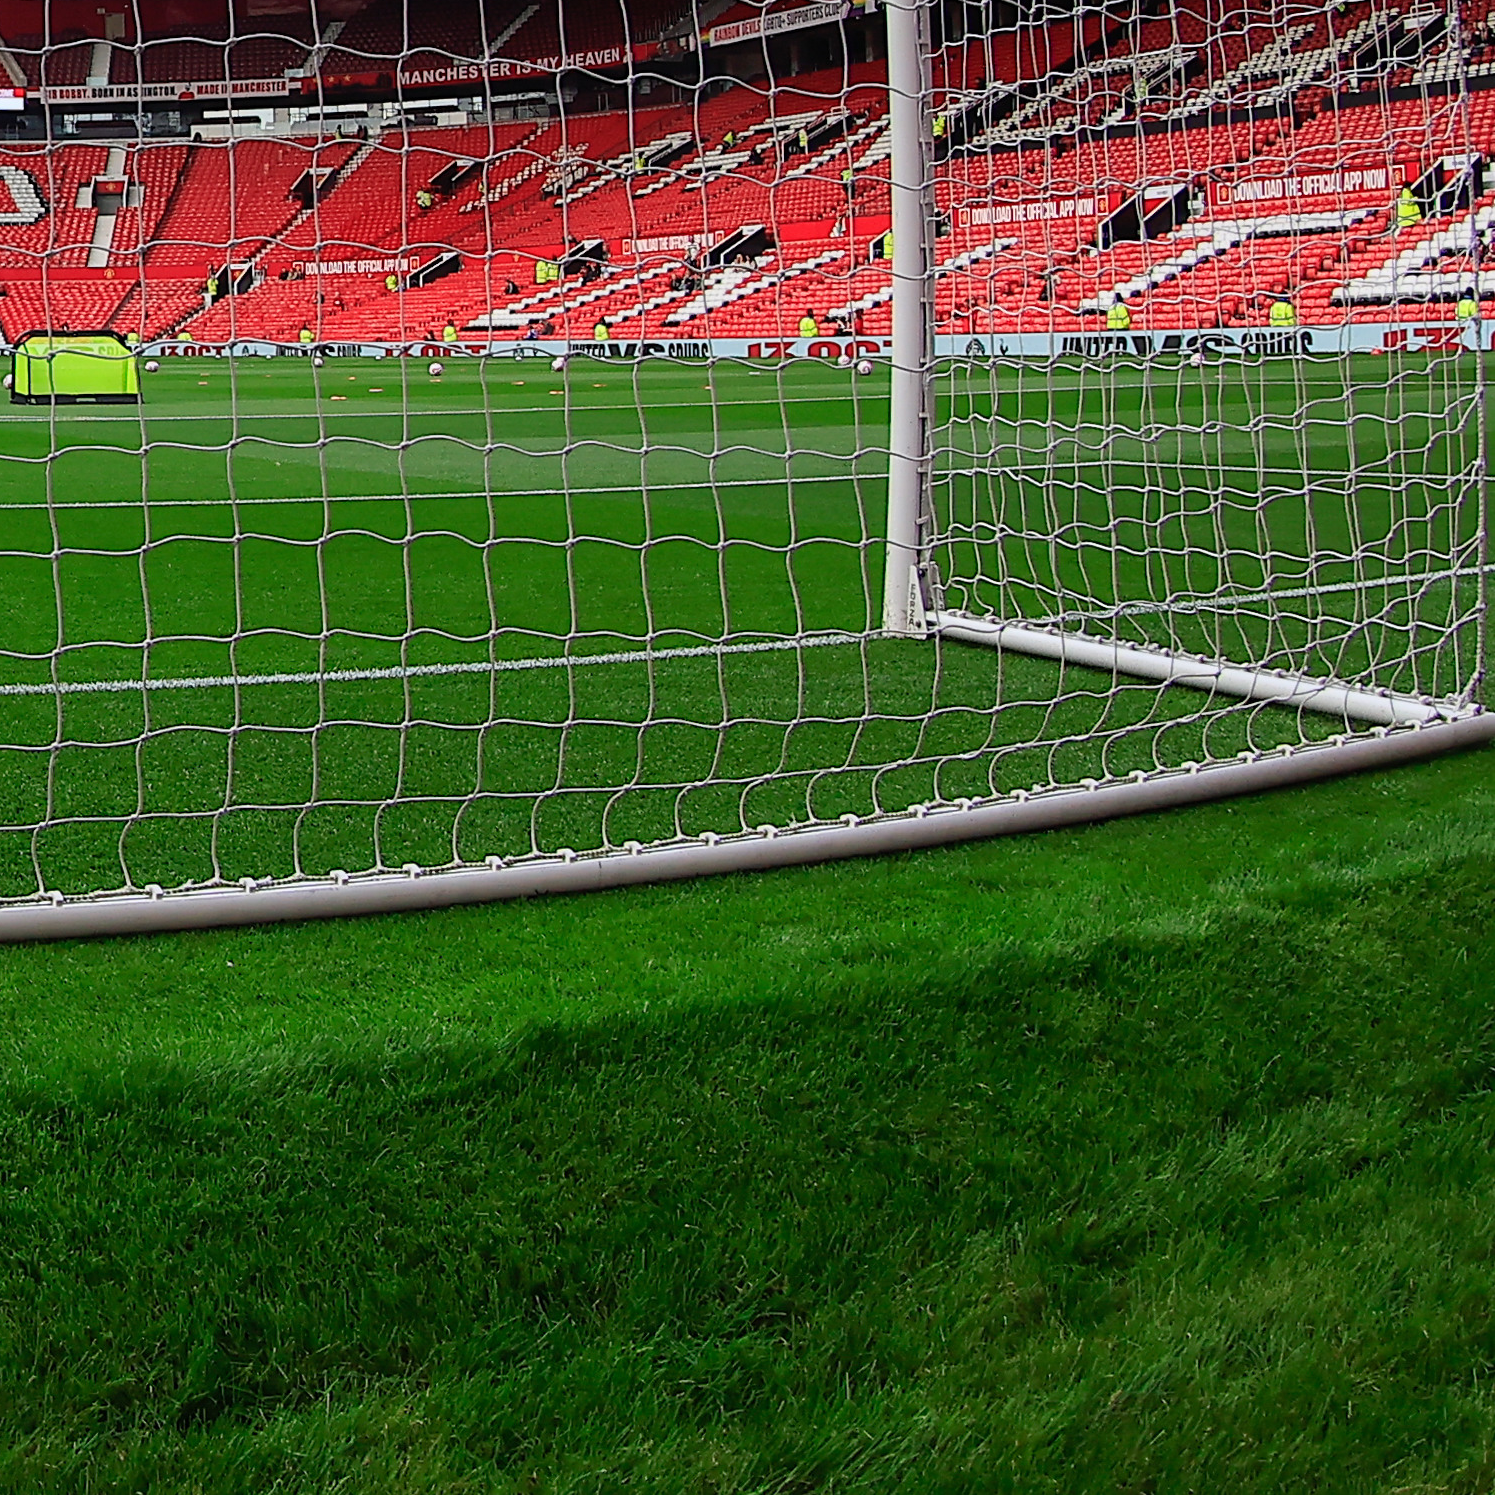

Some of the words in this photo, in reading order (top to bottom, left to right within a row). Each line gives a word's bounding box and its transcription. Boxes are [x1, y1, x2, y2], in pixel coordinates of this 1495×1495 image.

[398, 62, 512, 86] MANCHESTER
[515, 61, 532, 76] IS
[536, 56, 560, 71] MY
[564, 48, 621, 68] HEAVEN
[44, 89, 58, 99] IR
[59, 87, 90, 99] BOBBY.
[91, 88, 114, 98] BORN
[115, 87, 126, 98] IN
[127, 86, 178, 98] ASINGTON.
[197, 83, 221, 95] MADE
[231, 80, 287, 94] MANCHESTER
[1233, 179, 1283, 202] DOWNLOAD
[1284, 176, 1302, 197] THE
[1302, 172, 1341, 196] OFFICIAL
[1343, 170, 1362, 192] APP
[1363, 167, 1385, 190] NOW
[1012, 204, 1027, 222] THE
[1027, 200, 1058, 221] OFFICIAL
[1060, 199, 1075, 218] APP
[1076, 197, 1094, 216] NOW
[305, 261, 343, 275] DONLOAD
[343, 260, 357, 274] THE
[395, 258, 409, 271] NW
[807, 340, 892, 358] OC
